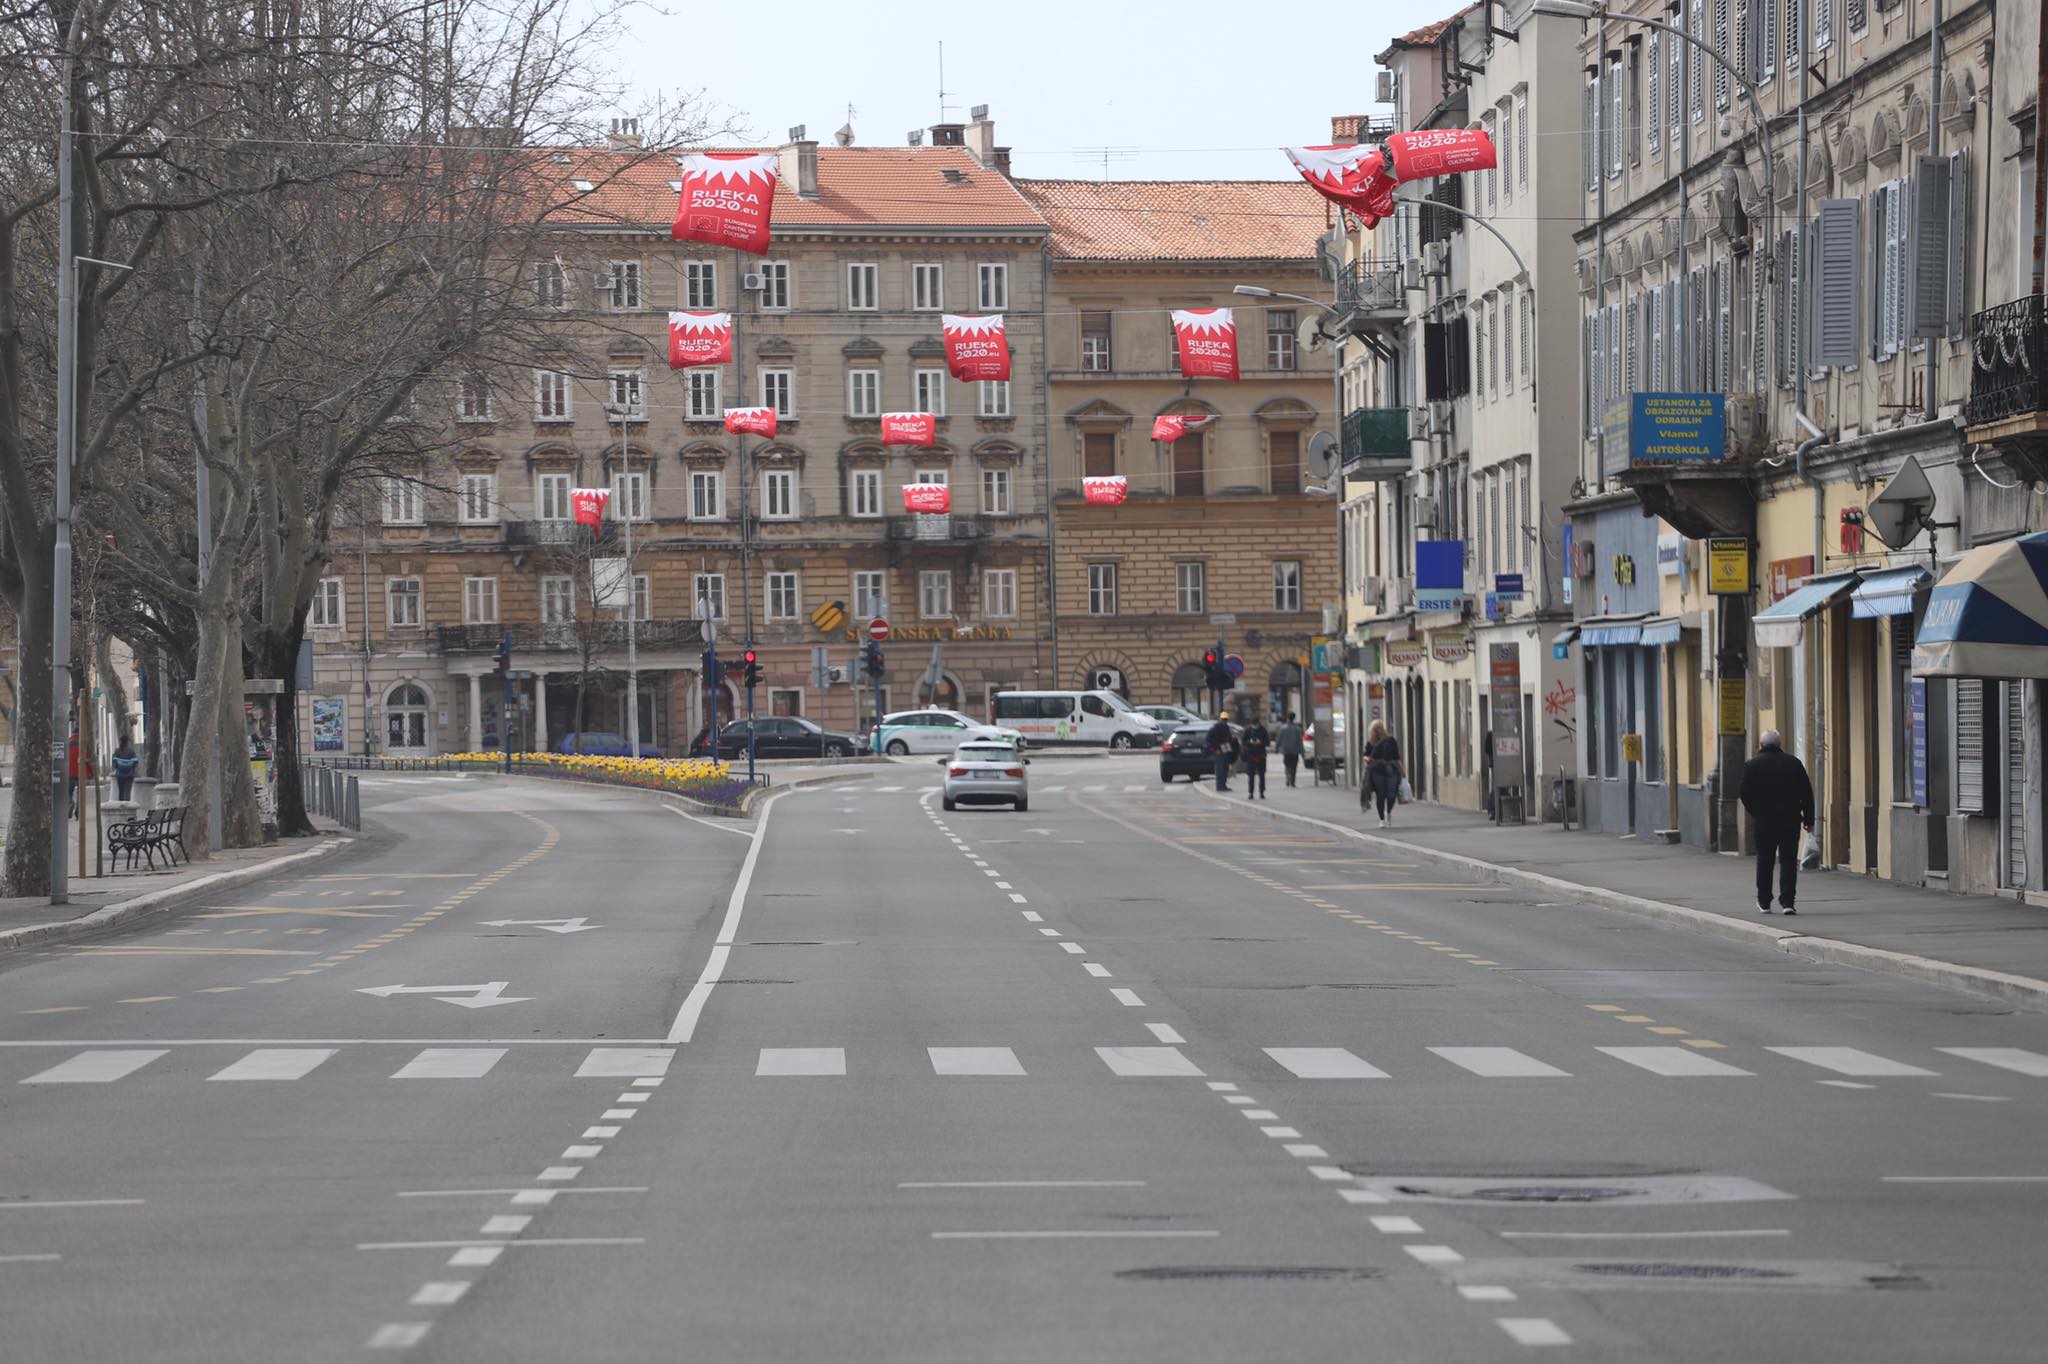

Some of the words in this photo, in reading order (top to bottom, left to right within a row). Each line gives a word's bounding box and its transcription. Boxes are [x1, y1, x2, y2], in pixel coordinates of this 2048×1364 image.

[1405, 130, 1473, 143] RIJEKA
[1407, 137, 1476, 151] 2020.eu
[692, 189, 759, 205] RIJEKA
[690, 198, 759, 216] 2020.eu
[955, 341, 999, 351] RIJEKA
[1187, 339, 1231, 350] RIJEKA
[1647, 399, 1697, 407] USTANOVA
[1699, 399, 1712, 407] ZA
[1645, 408, 1713, 416] OBRAZOVANJE
[1655, 416, 1702, 425] ODRASLIH
[1646, 444, 1710, 454] AUTOŠKOLA
[1419, 599, 1451, 609] ERSTE
[846, 625, 942, 641] SLINSKA
[1435, 647, 1467, 657] ROKO
